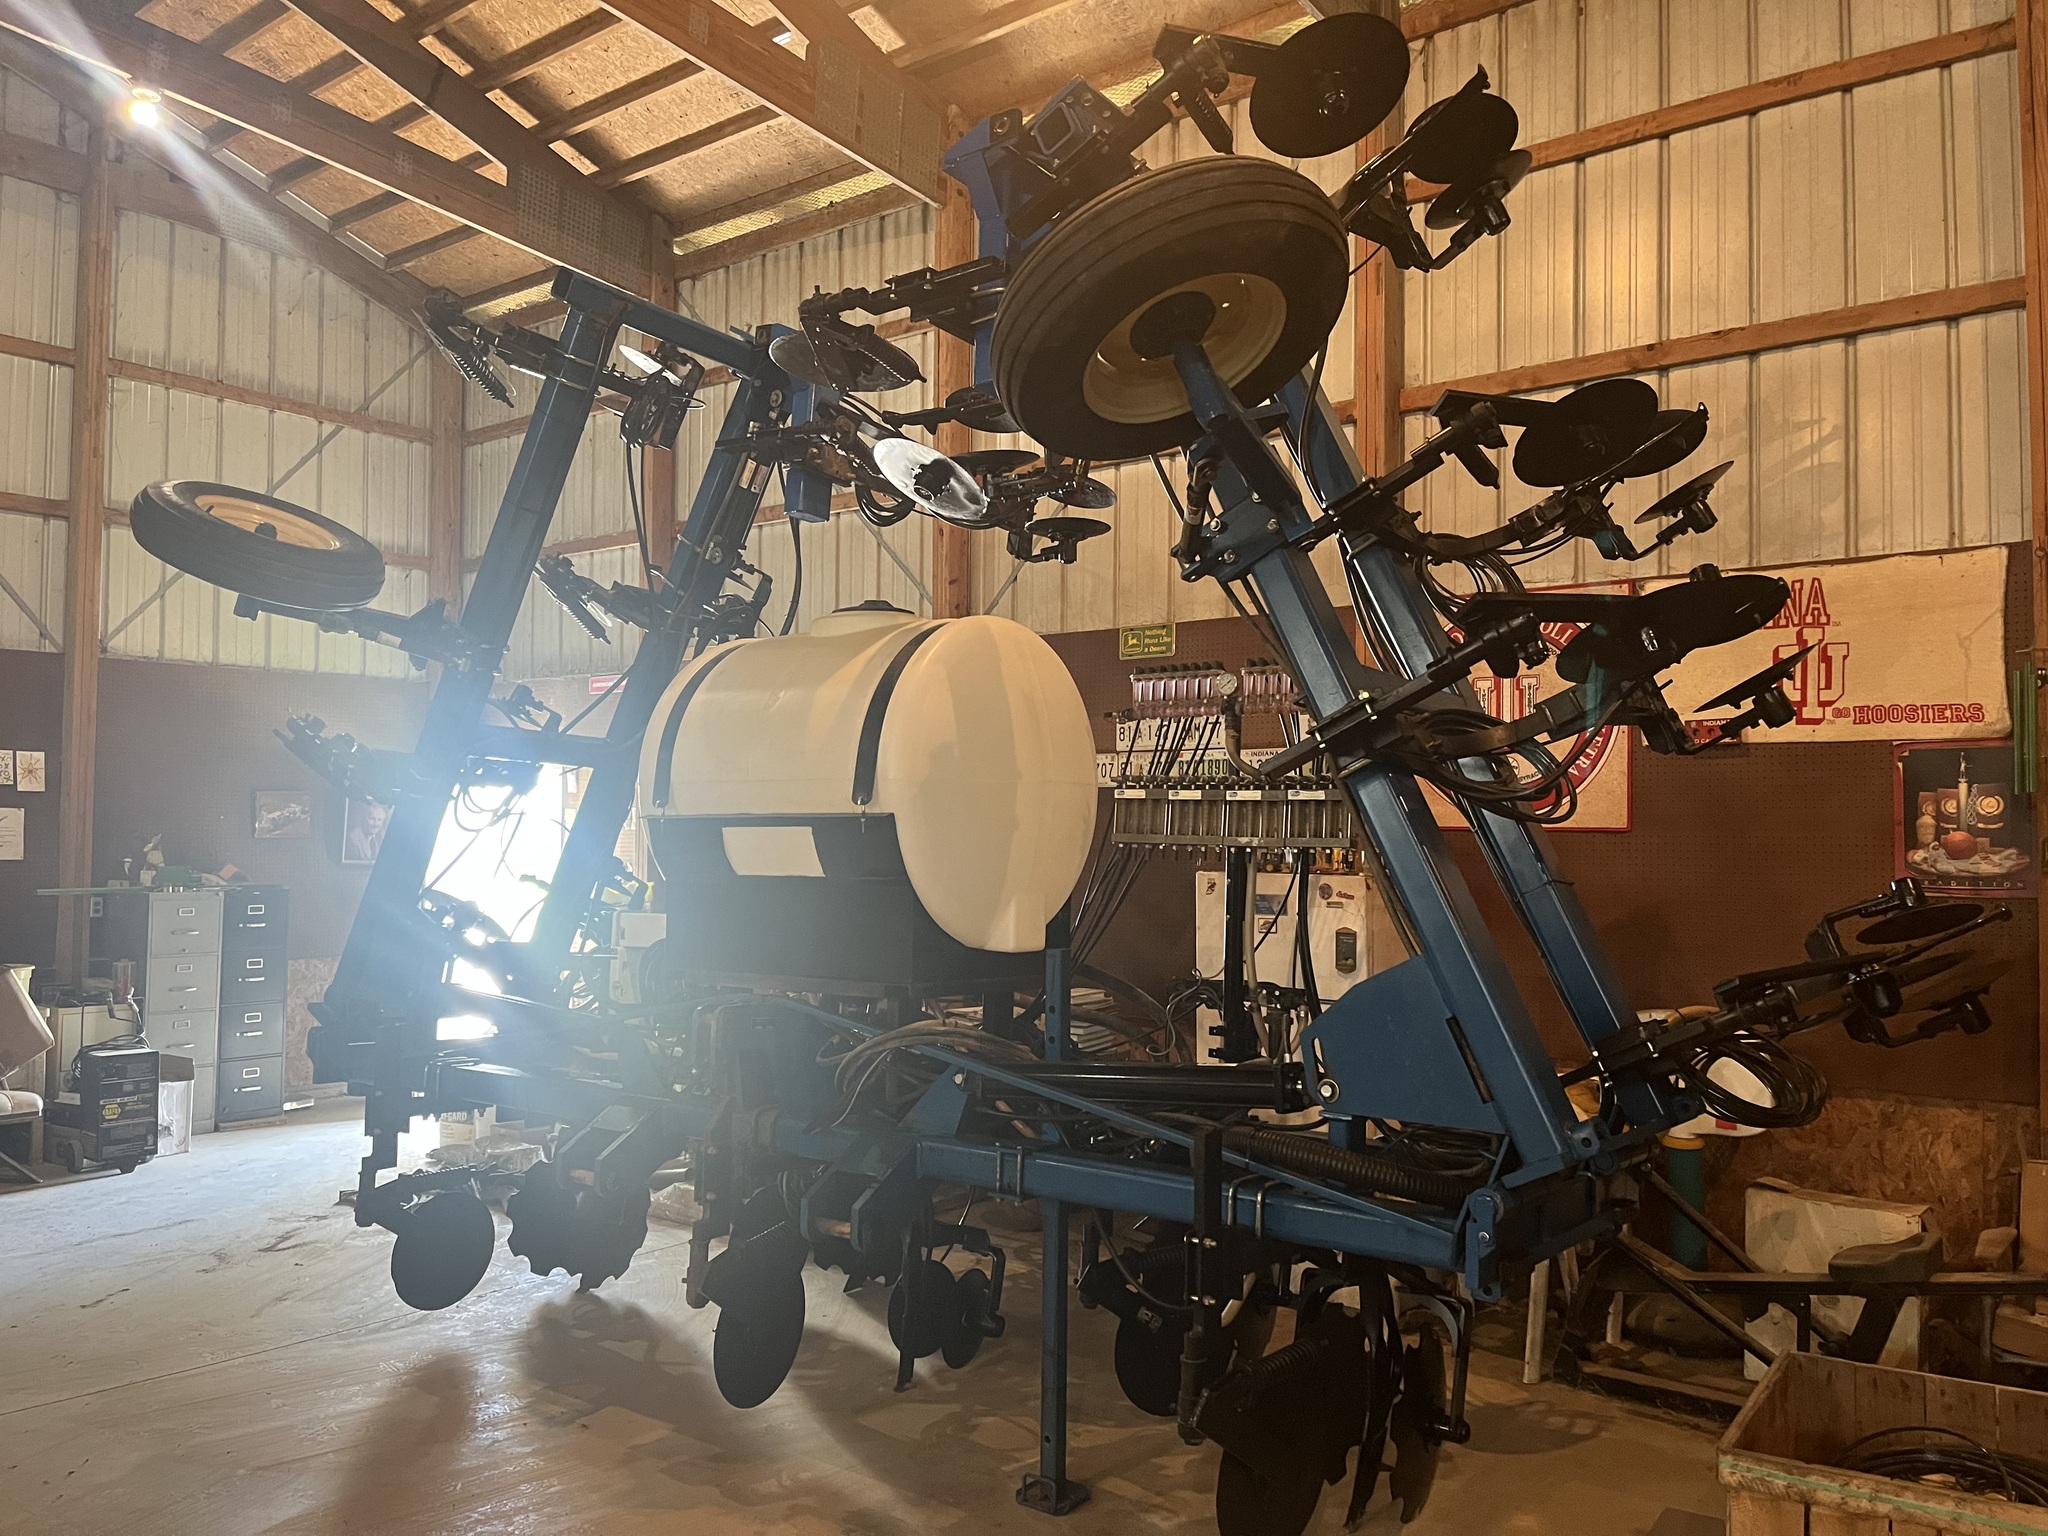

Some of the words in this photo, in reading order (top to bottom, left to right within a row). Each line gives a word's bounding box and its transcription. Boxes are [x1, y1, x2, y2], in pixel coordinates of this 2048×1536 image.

[1144, 628, 1167, 636] Nothing
[1832, 707, 1850, 718] GO
[1853, 703, 1985, 725] HOOSIERS
